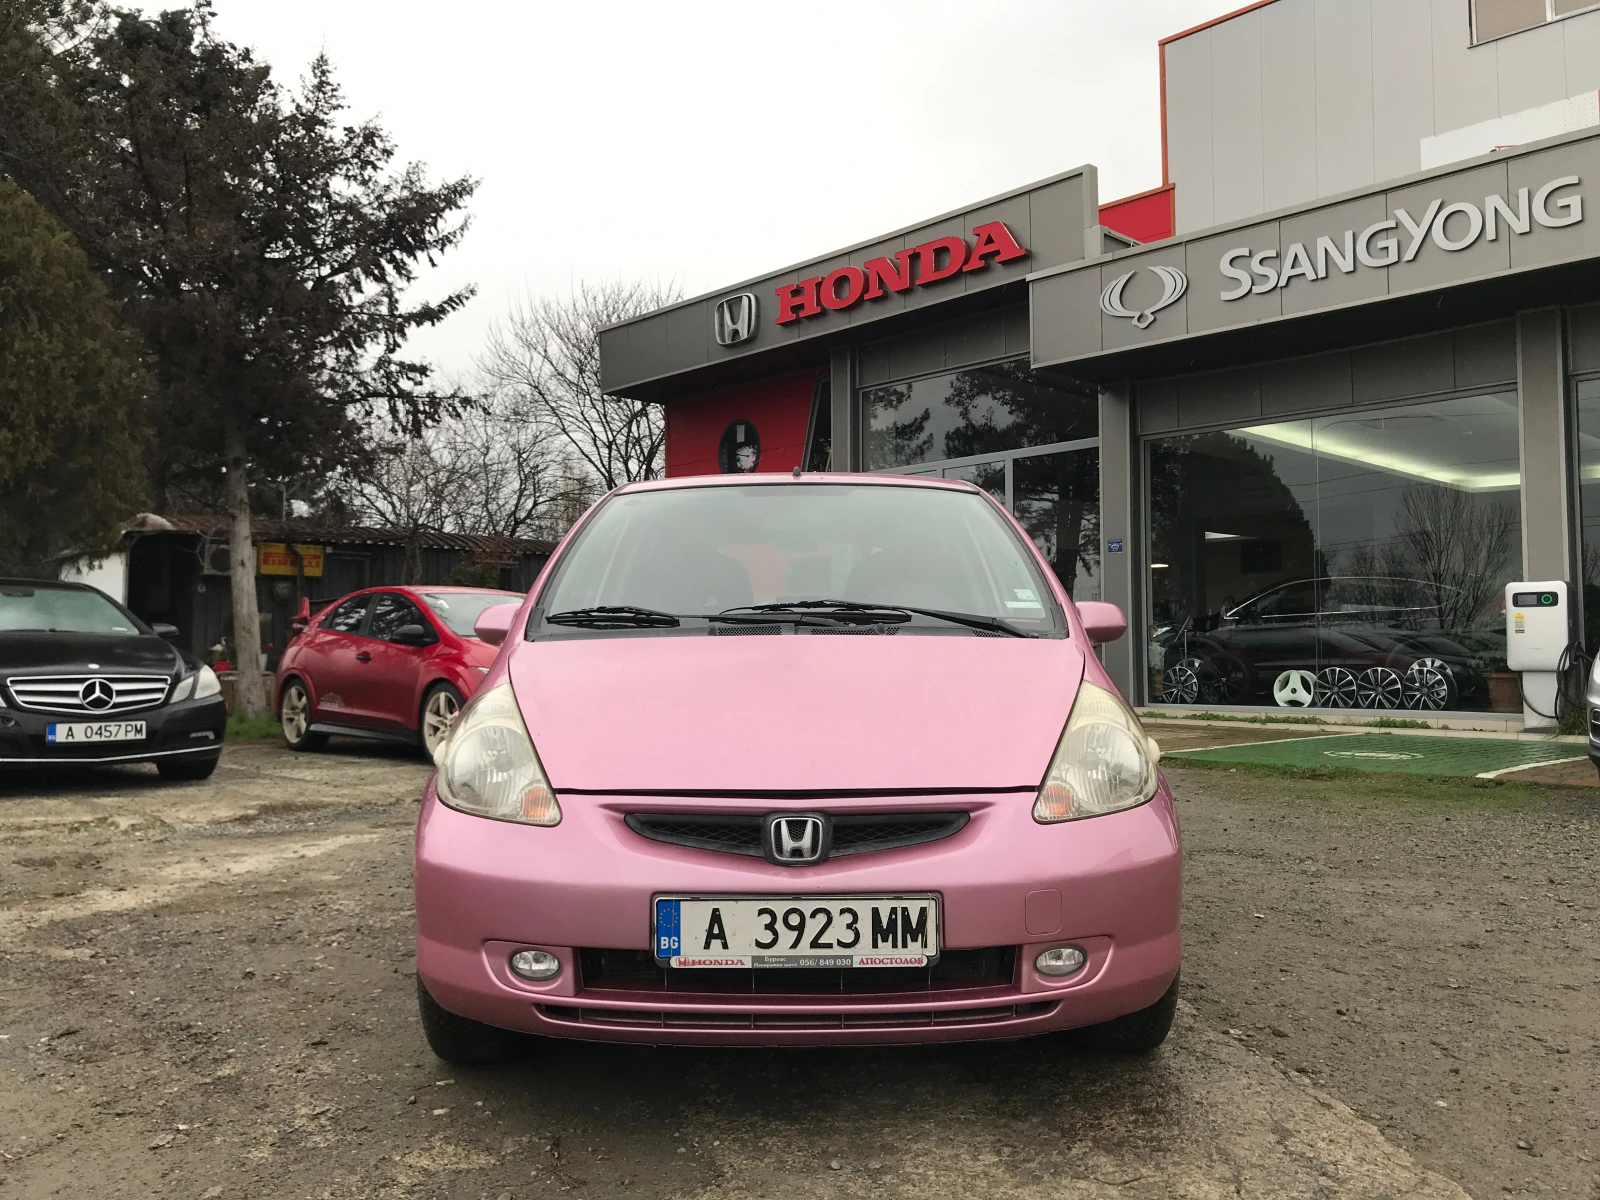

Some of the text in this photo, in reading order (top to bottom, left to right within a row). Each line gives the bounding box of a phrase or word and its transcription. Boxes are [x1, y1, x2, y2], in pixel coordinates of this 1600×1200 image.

[1219, 175, 1583, 301] SSANGYONG
[774, 220, 1030, 326] HONDA
[262, 552, 321, 569] PIRELI
[65, 726, 75, 740] A
[84, 724, 122, 739] 0457
[124, 723, 144, 738] PM
[703, 906, 928, 950] A 3923 MM
[660, 936, 679, 950] BG
[799, 958, 852, 967] 056/ 849 030
